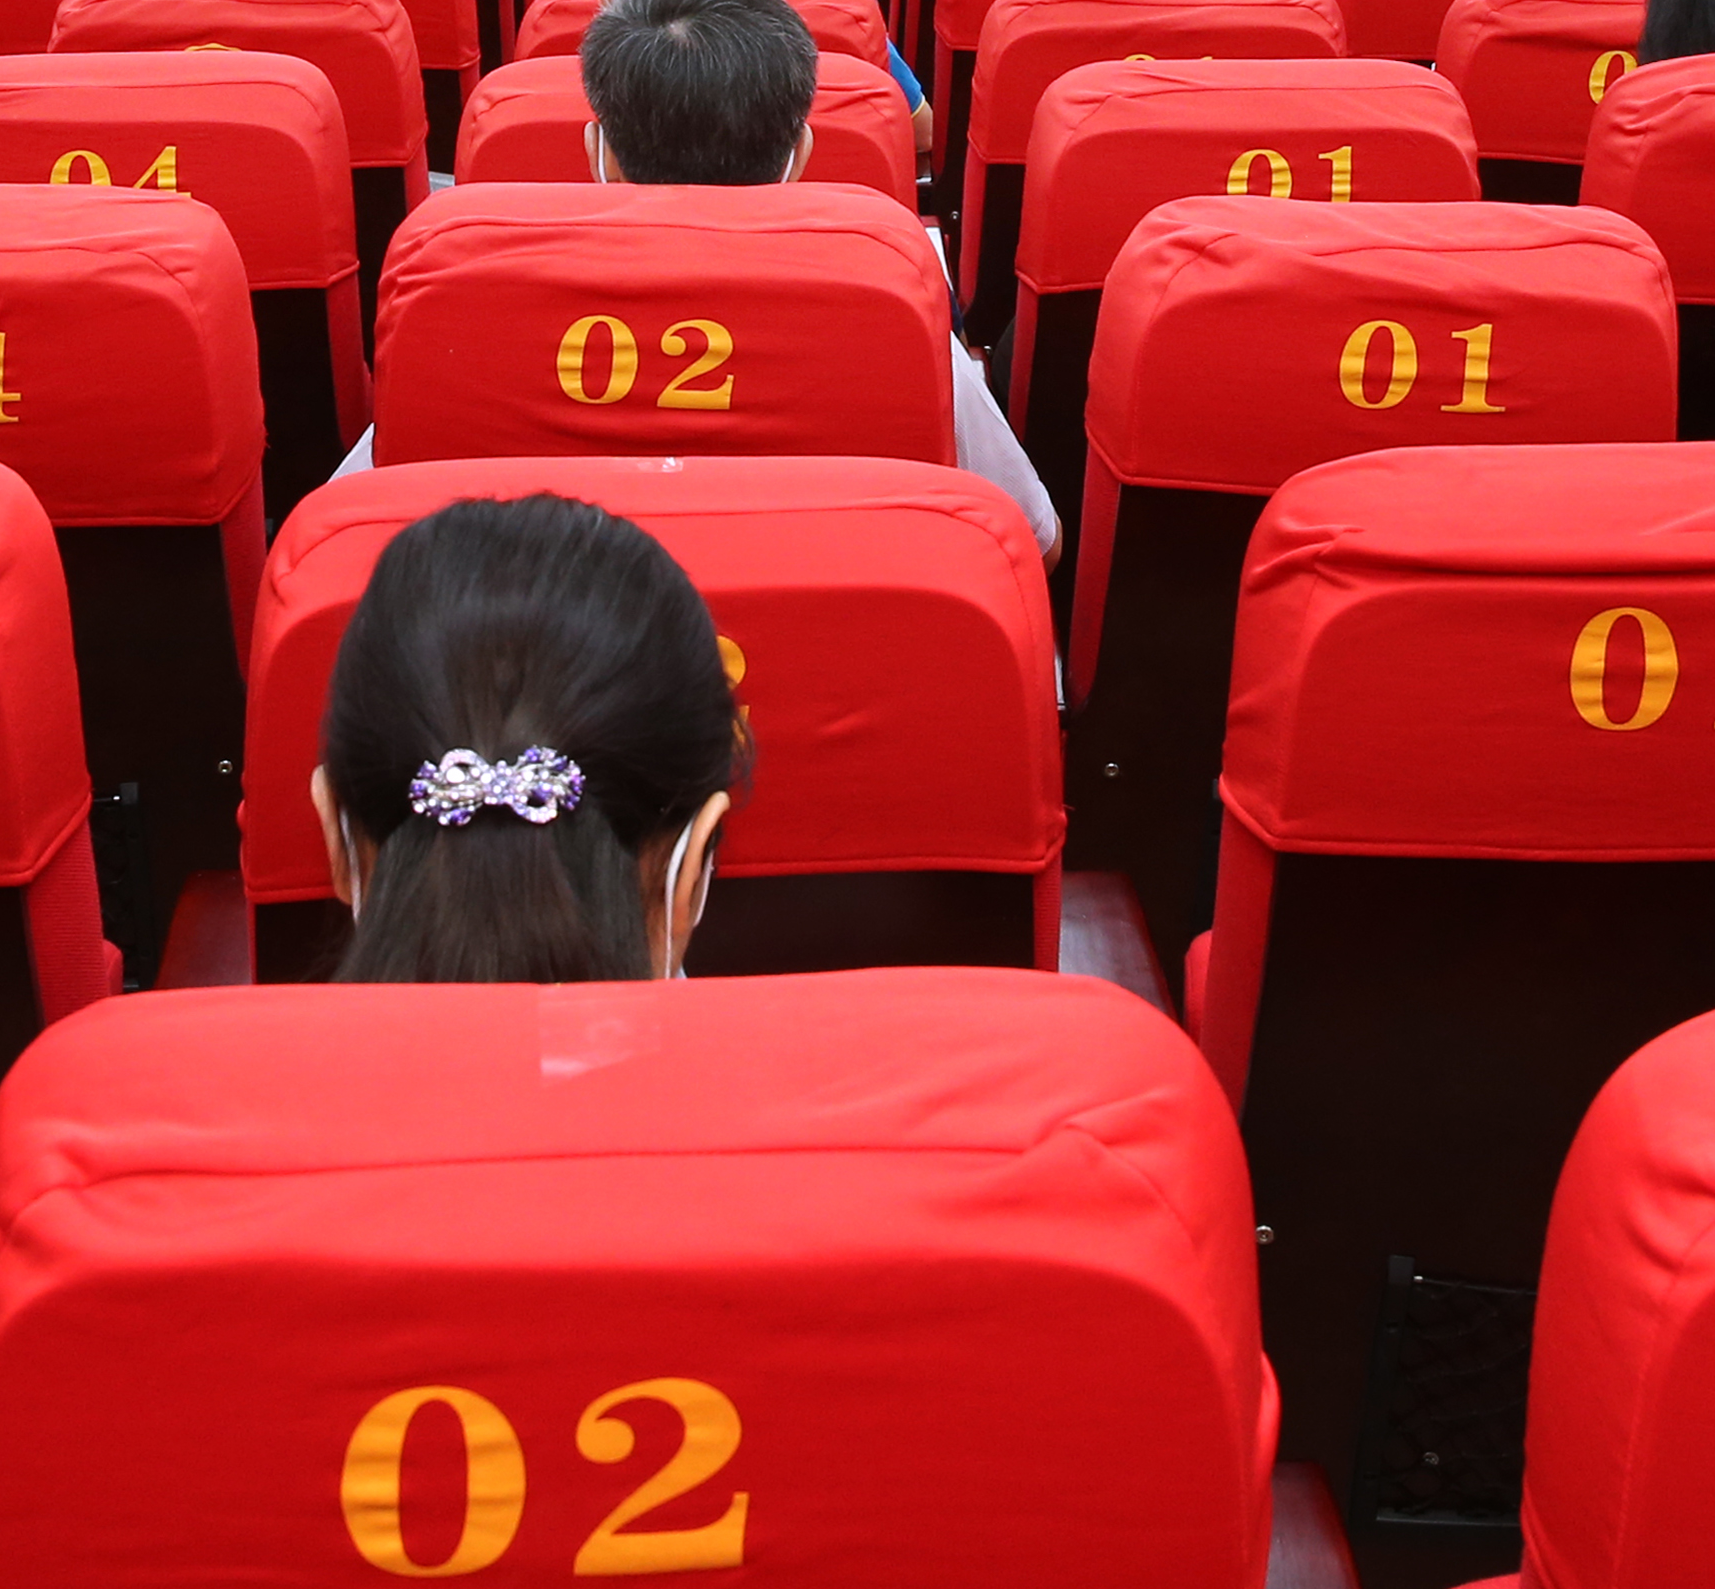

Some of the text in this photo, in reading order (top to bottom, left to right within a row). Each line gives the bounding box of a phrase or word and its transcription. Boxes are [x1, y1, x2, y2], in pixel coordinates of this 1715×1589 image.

[1227, 146, 1354, 204] 01
[557, 316, 735, 411] 02
[1340, 321, 1503, 414] 01
[342, 1379, 749, 1576] 02
